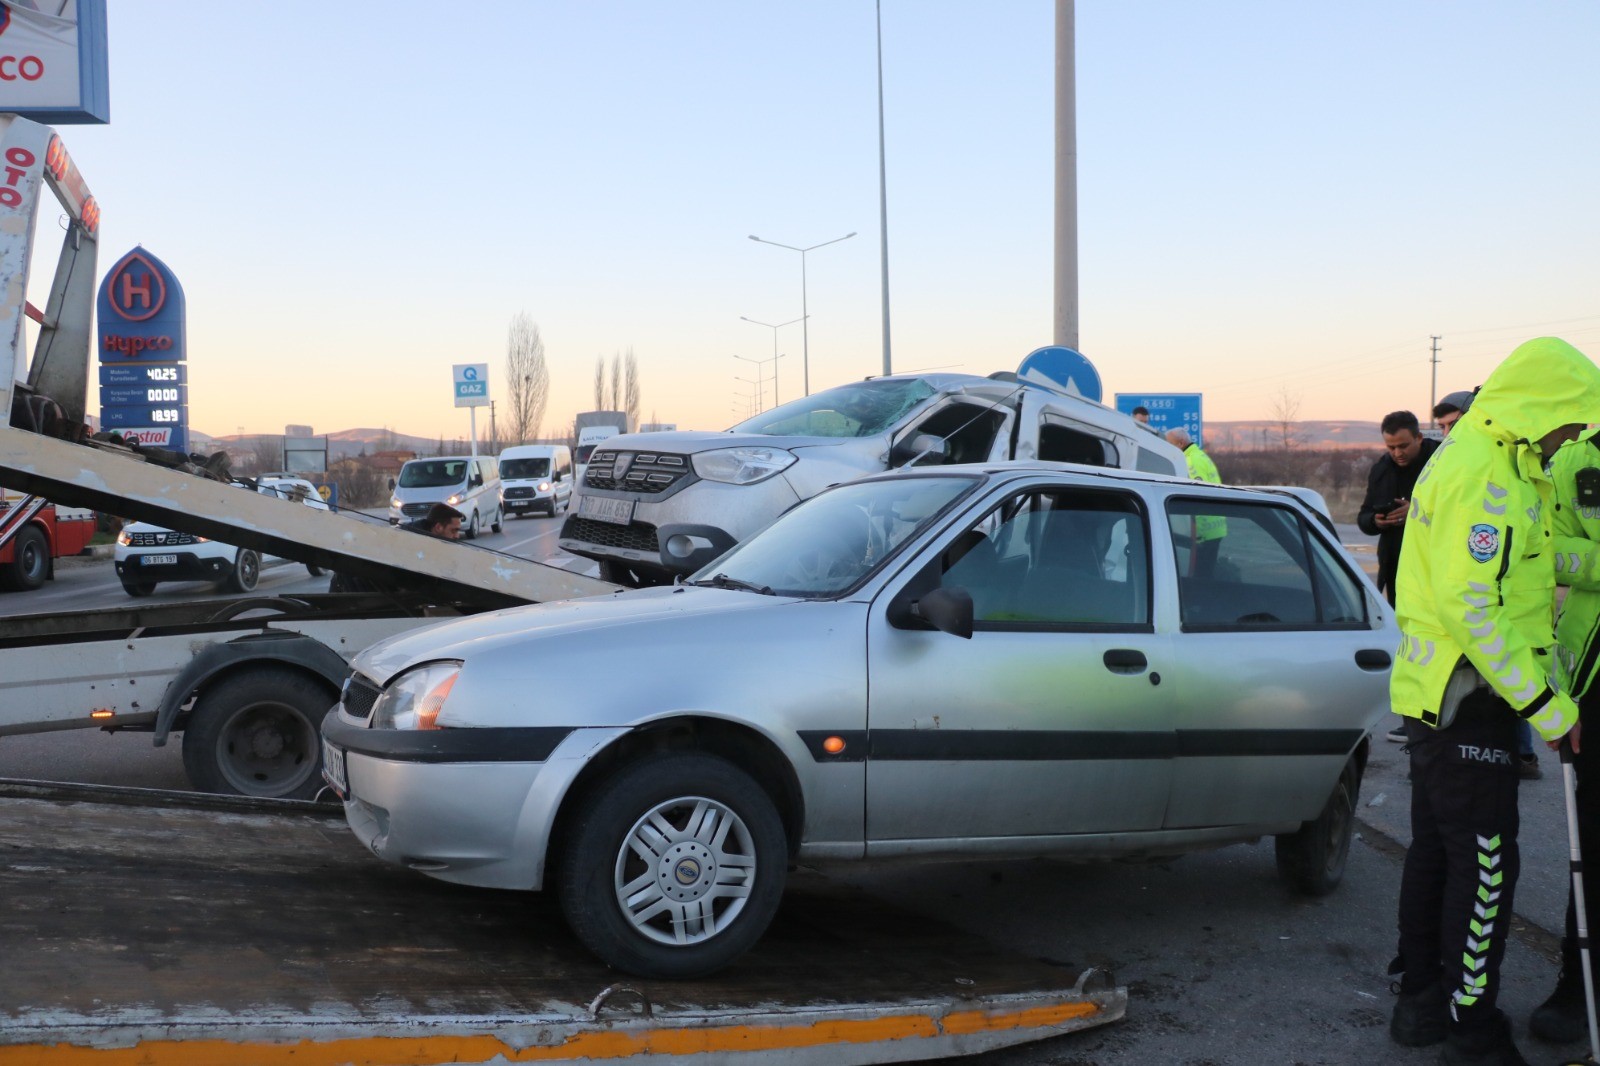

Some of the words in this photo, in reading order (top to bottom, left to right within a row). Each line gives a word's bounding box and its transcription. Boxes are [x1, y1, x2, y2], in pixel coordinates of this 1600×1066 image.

[123, 273, 150, 309] H
[104, 334, 173, 356] Hypco
[147, 368, 177, 380] 40.25
[461, 384, 481, 394] GAZ
[152, 409, 178, 422] 18.99
[614, 502, 631, 518] 853
